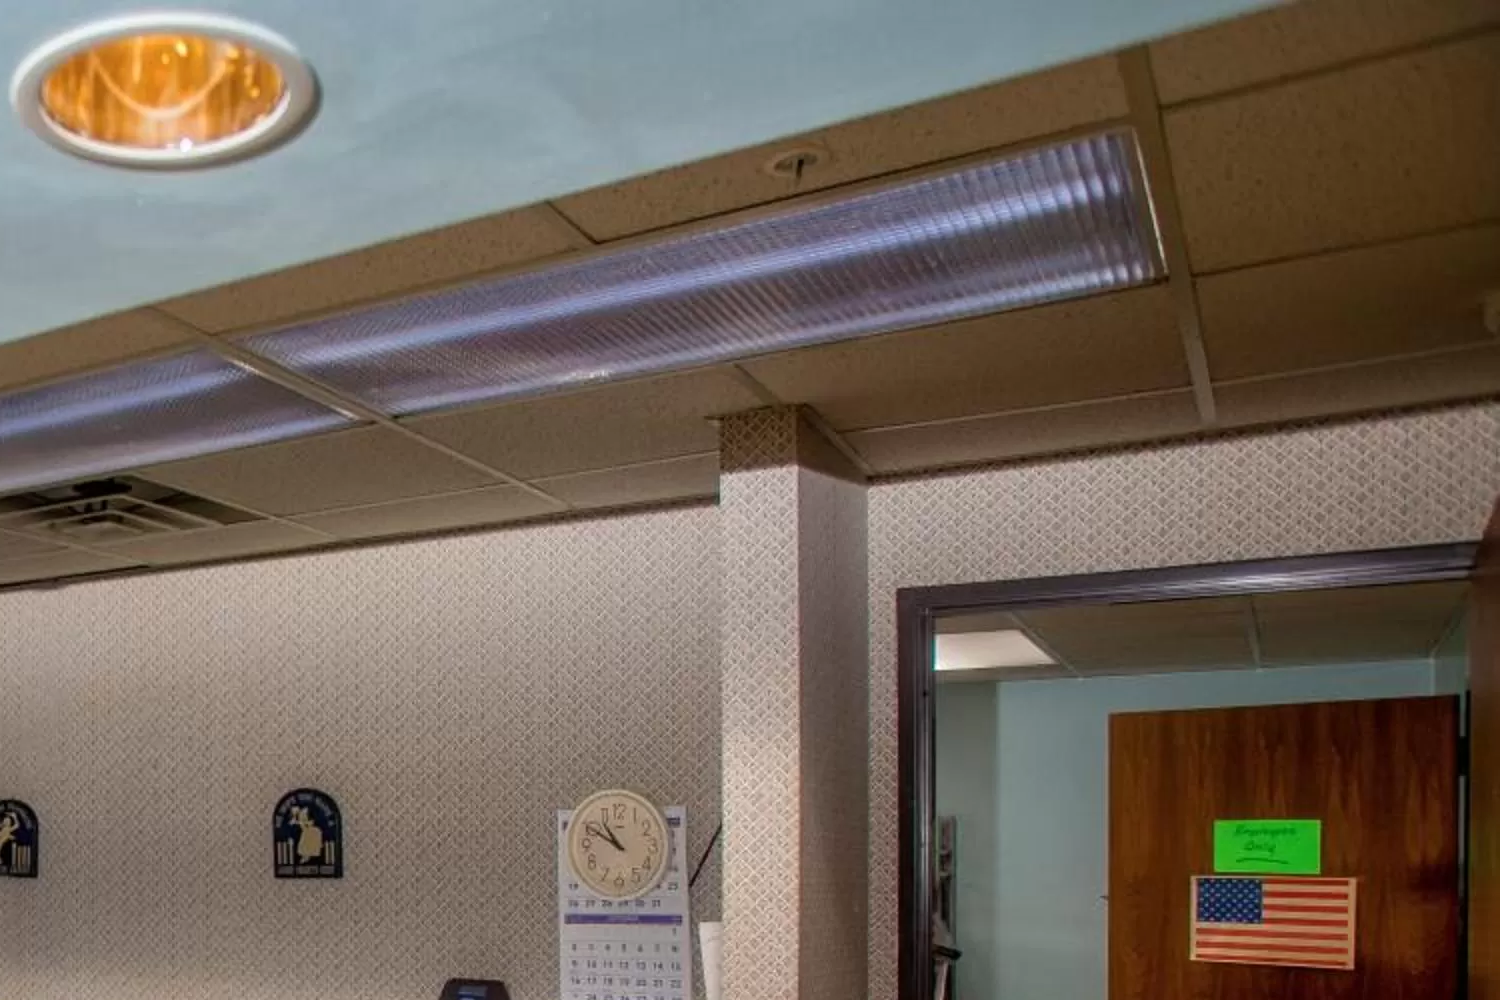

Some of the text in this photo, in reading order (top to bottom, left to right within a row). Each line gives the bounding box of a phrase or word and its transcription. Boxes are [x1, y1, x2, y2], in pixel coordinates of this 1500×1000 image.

[612, 803, 626, 820] 12
[642, 820, 651, 836] 2
[581, 838, 591, 852] 9
[649, 837, 658, 854] 3
[588, 853, 596, 870] 8
[642, 856, 651, 870] 4
[601, 868, 610, 881] 7
[632, 867, 641, 882] 5
